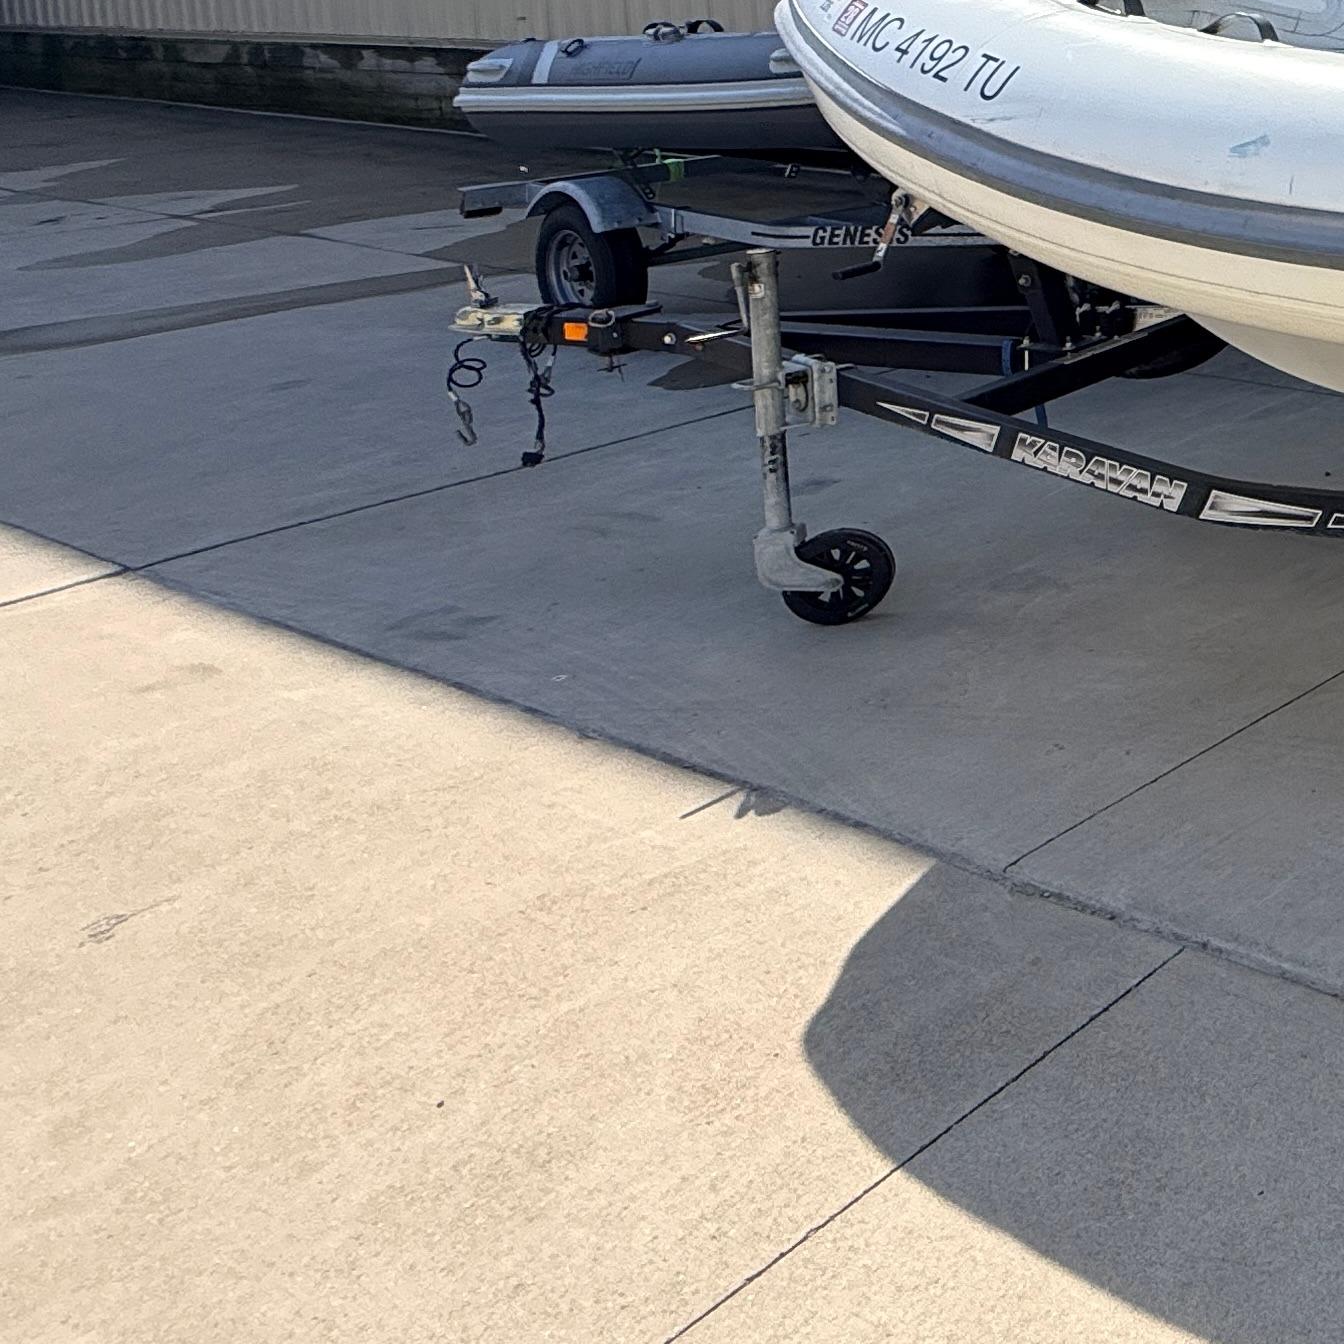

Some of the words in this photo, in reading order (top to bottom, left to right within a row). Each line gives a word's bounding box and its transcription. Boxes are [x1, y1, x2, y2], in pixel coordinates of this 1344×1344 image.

[850, 7, 905, 53] MC
[894, 28, 970, 83] 4192
[963, 52, 1021, 101] TU
[811, 224, 912, 247] GENESS
[1011, 432, 1187, 512] KARAVAN
